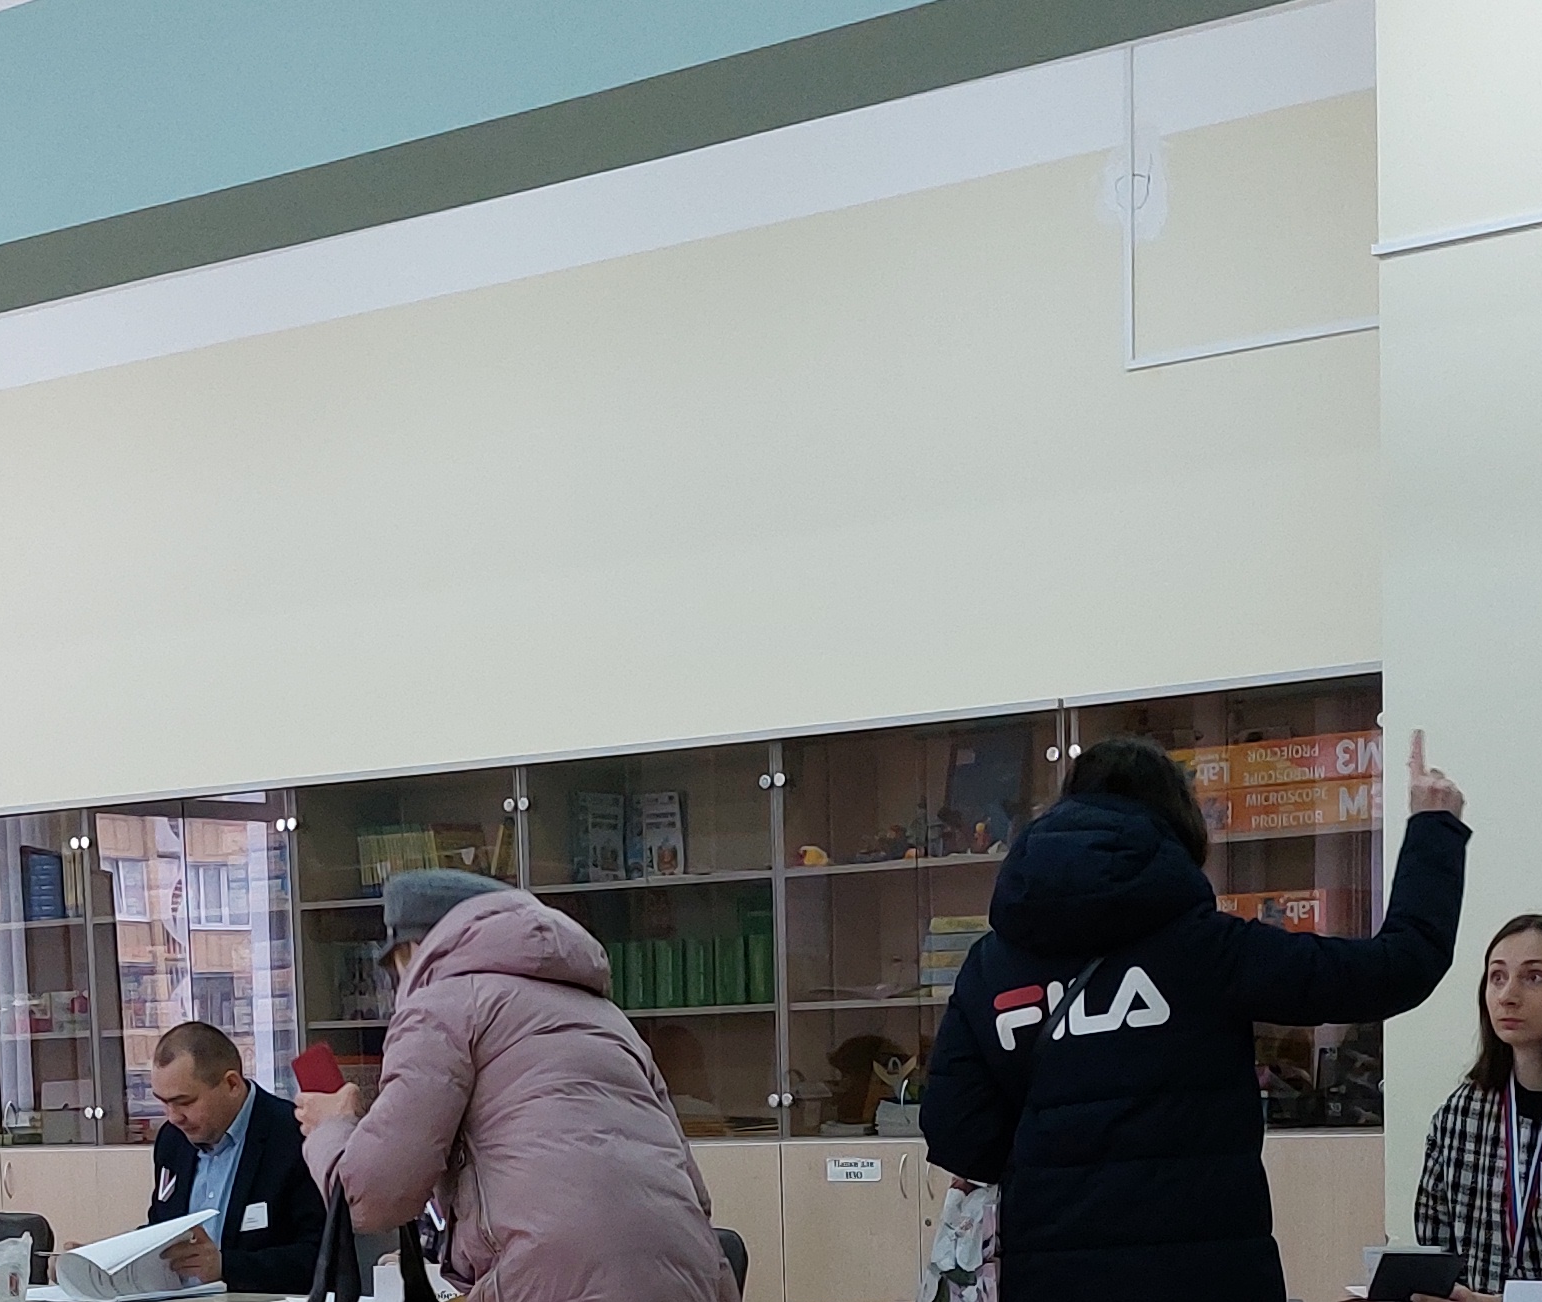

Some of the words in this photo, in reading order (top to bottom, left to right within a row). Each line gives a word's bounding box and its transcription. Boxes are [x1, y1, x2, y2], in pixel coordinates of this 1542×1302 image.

[1247, 742, 1320, 763] PROJECTOR
[1336, 737, 1383, 774] M3
[1196, 762, 1230, 786] Lab
[1243, 764, 1326, 787] MICROSCOPE
[1245, 786, 1328, 808] MICROSCOPE
[1251, 809, 1324, 830] PROJECTOR
[1285, 900, 1320, 925] Lab
[993, 966, 1171, 1050] FILA
